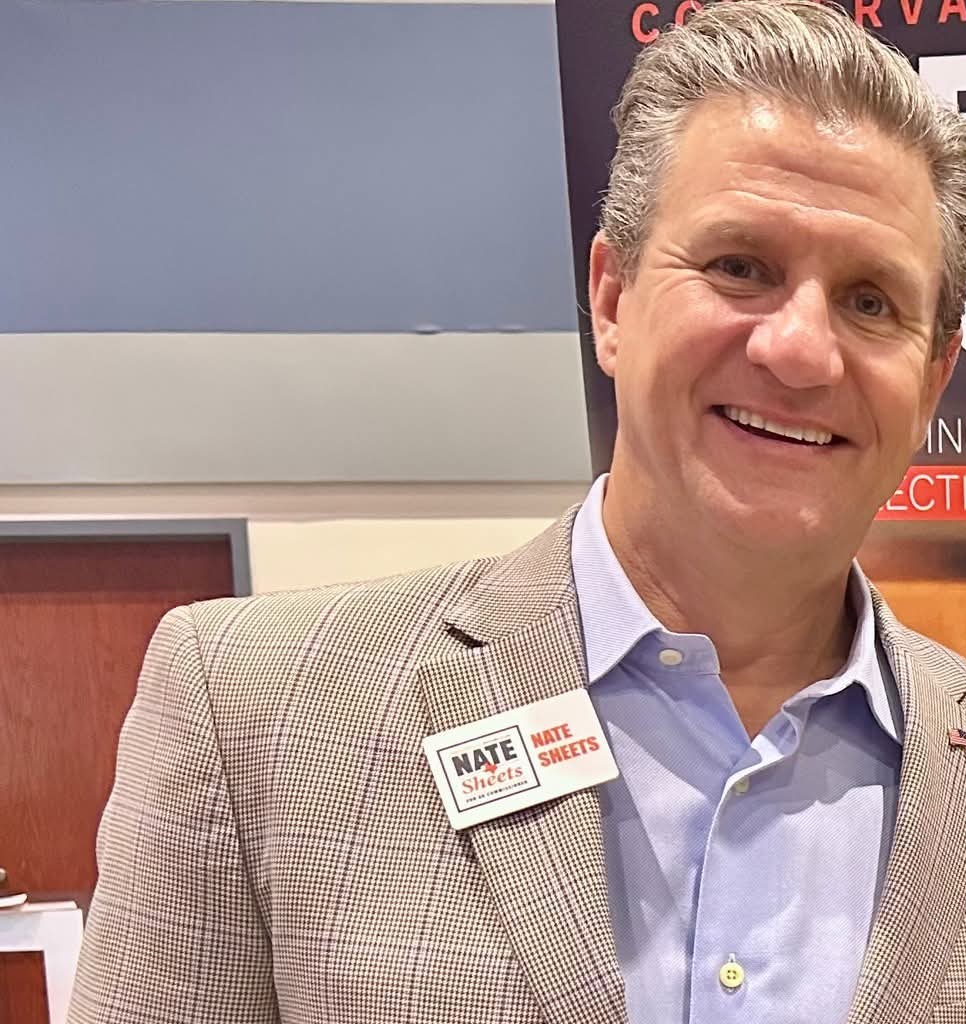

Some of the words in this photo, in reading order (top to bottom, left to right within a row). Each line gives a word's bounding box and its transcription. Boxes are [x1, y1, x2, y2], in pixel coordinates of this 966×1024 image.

[530, 723, 572, 748] NATE
[451, 738, 517, 776] NATE
[538, 736, 599, 767] SHEETS
[461, 766, 524, 795] Sheets
